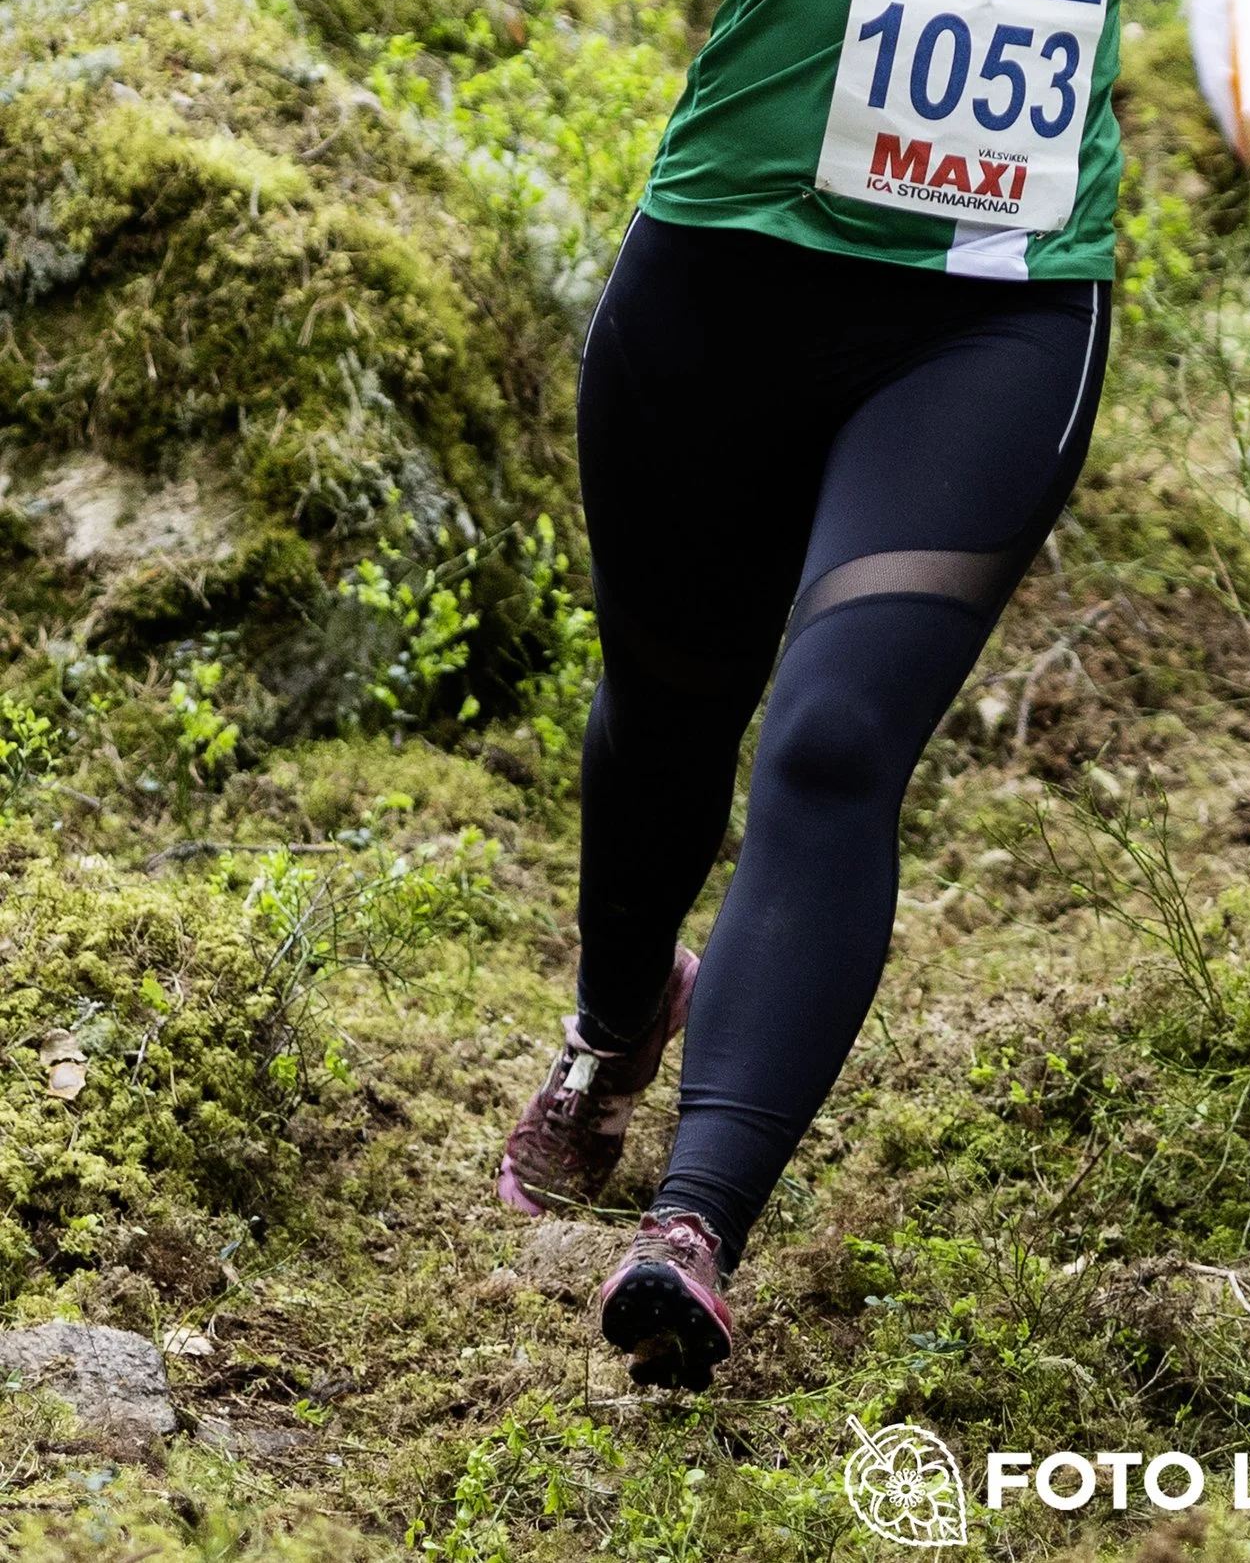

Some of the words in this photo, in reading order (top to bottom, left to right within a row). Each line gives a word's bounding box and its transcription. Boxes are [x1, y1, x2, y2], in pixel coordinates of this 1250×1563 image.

[858, 2, 1080, 139] 1053
[870, 132, 1027, 200] MAXI
[978, 148, 1029, 163] VÄLSVIKEN
[866, 177, 893, 194] ICA
[897, 183, 1020, 215] STORMARKNAD
